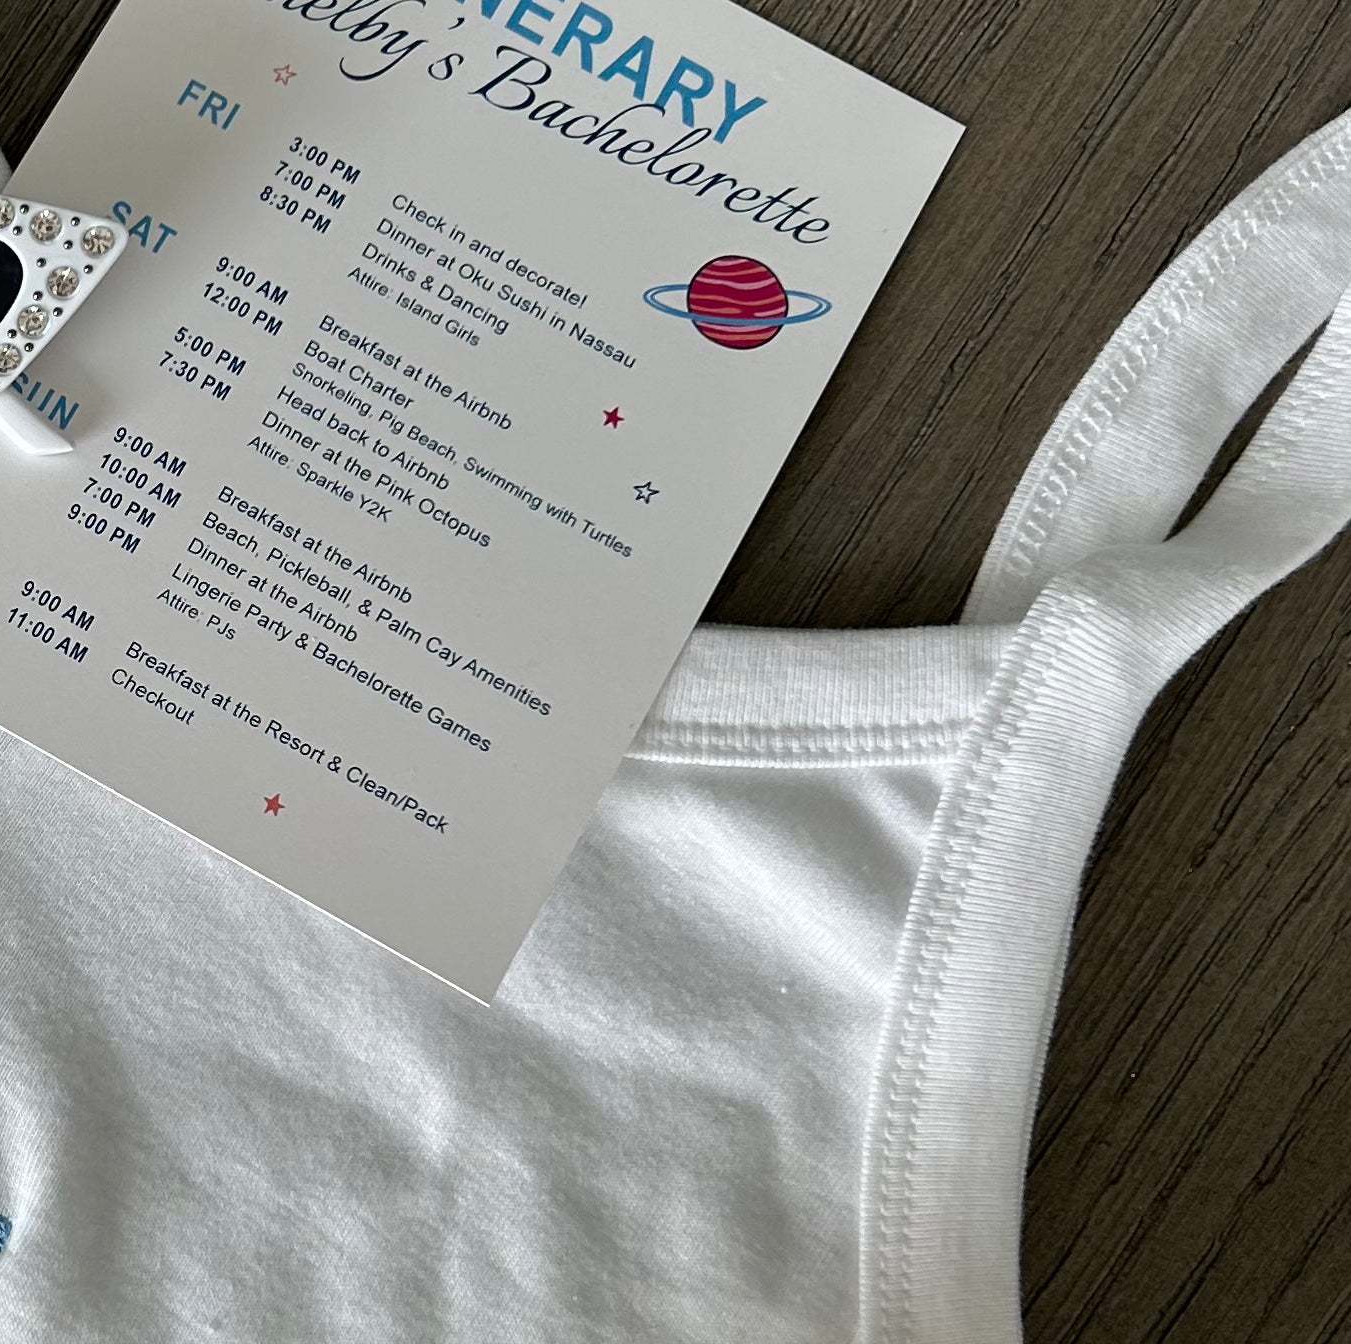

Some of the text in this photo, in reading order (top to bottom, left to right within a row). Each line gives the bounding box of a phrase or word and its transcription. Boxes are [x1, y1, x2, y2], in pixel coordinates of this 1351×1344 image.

[178, 80, 240, 130] FRI
[289, 137, 361, 184] 3:00 PM
[469, 45, 831, 244] Bachelorette
[260, 186, 331, 234] 8:30 PM
[275, 160, 346, 209] 7:00 PM
[112, 201, 177, 254] SAT
[393, 194, 588, 309] Check in and decorate!
[216, 257, 288, 305] 9:00 AM
[347, 267, 480, 346] Attire: Island Girls
[362, 243, 509, 335] Drinks & Dancing
[377, 218, 636, 368] Dinner at Oku Sushi in Nassau
[204, 283, 283, 336] 12:00 PM
[160, 351, 231, 401] 7:30 PM
[175, 327, 246, 376] 5:00 PM
[304, 340, 414, 409] Boat Charter
[319, 315, 511, 429] Breakfast at the Airbnb
[114, 427, 186, 477] 9:00 AM
[277, 385, 449, 490] Head back to Airbnb
[293, 363, 632, 557] Snorkeling, Pig Beach, Swimming with Turtles
[84, 477, 156, 528] 7:00 PM
[101, 454, 182, 508] 10:00 AM
[247, 437, 392, 522] Attire: Sparkle Y2K
[262, 411, 490, 547] Dinner at the Pink Octopus
[68, 504, 141, 554] 9:00 PM
[218, 486, 411, 603] Breakfast at the Airbnb
[21, 581, 94, 631] 9:00 AM
[157, 589, 236, 639] Attire: PJs
[187, 537, 357, 641] Dinner at the Airbnb
[203, 512, 551, 715] Beach, Pickleball, & Palm Cay Amenities
[8, 608, 88, 663] 11:00 AM
[172, 563, 491, 751] Lingerie Party & Bachelorette Games
[112, 669, 194, 725] Checkout
[126, 641, 448, 834] Breakfast at the Resort & Clean/Pack
